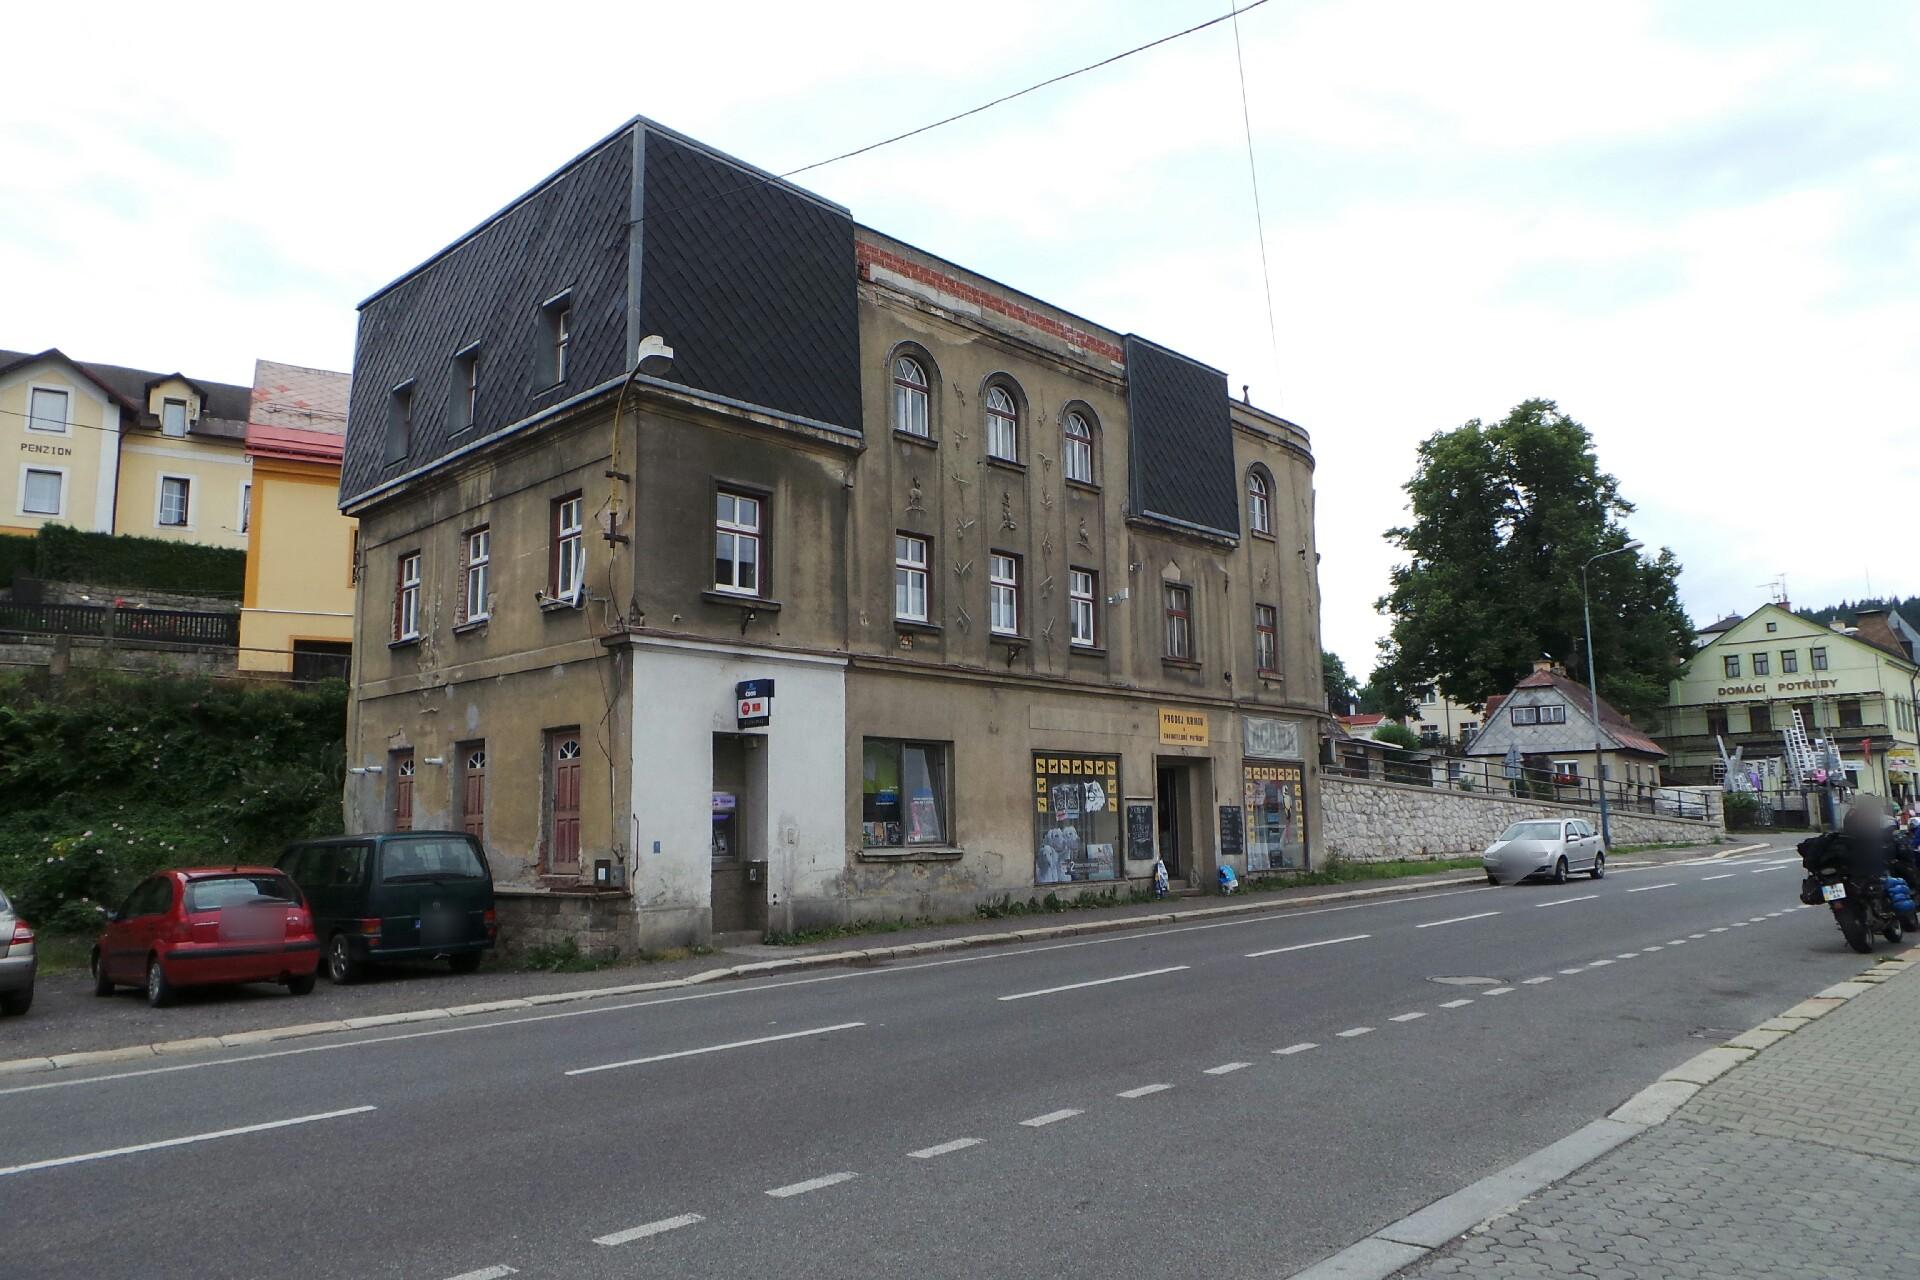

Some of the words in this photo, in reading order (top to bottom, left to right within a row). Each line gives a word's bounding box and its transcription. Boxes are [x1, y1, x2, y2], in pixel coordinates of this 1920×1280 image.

[20, 442, 72, 456] PENZION
[1717, 683, 1766, 696] DOMÁCÍ
[1777, 679, 1838, 691] POTŘEBY
